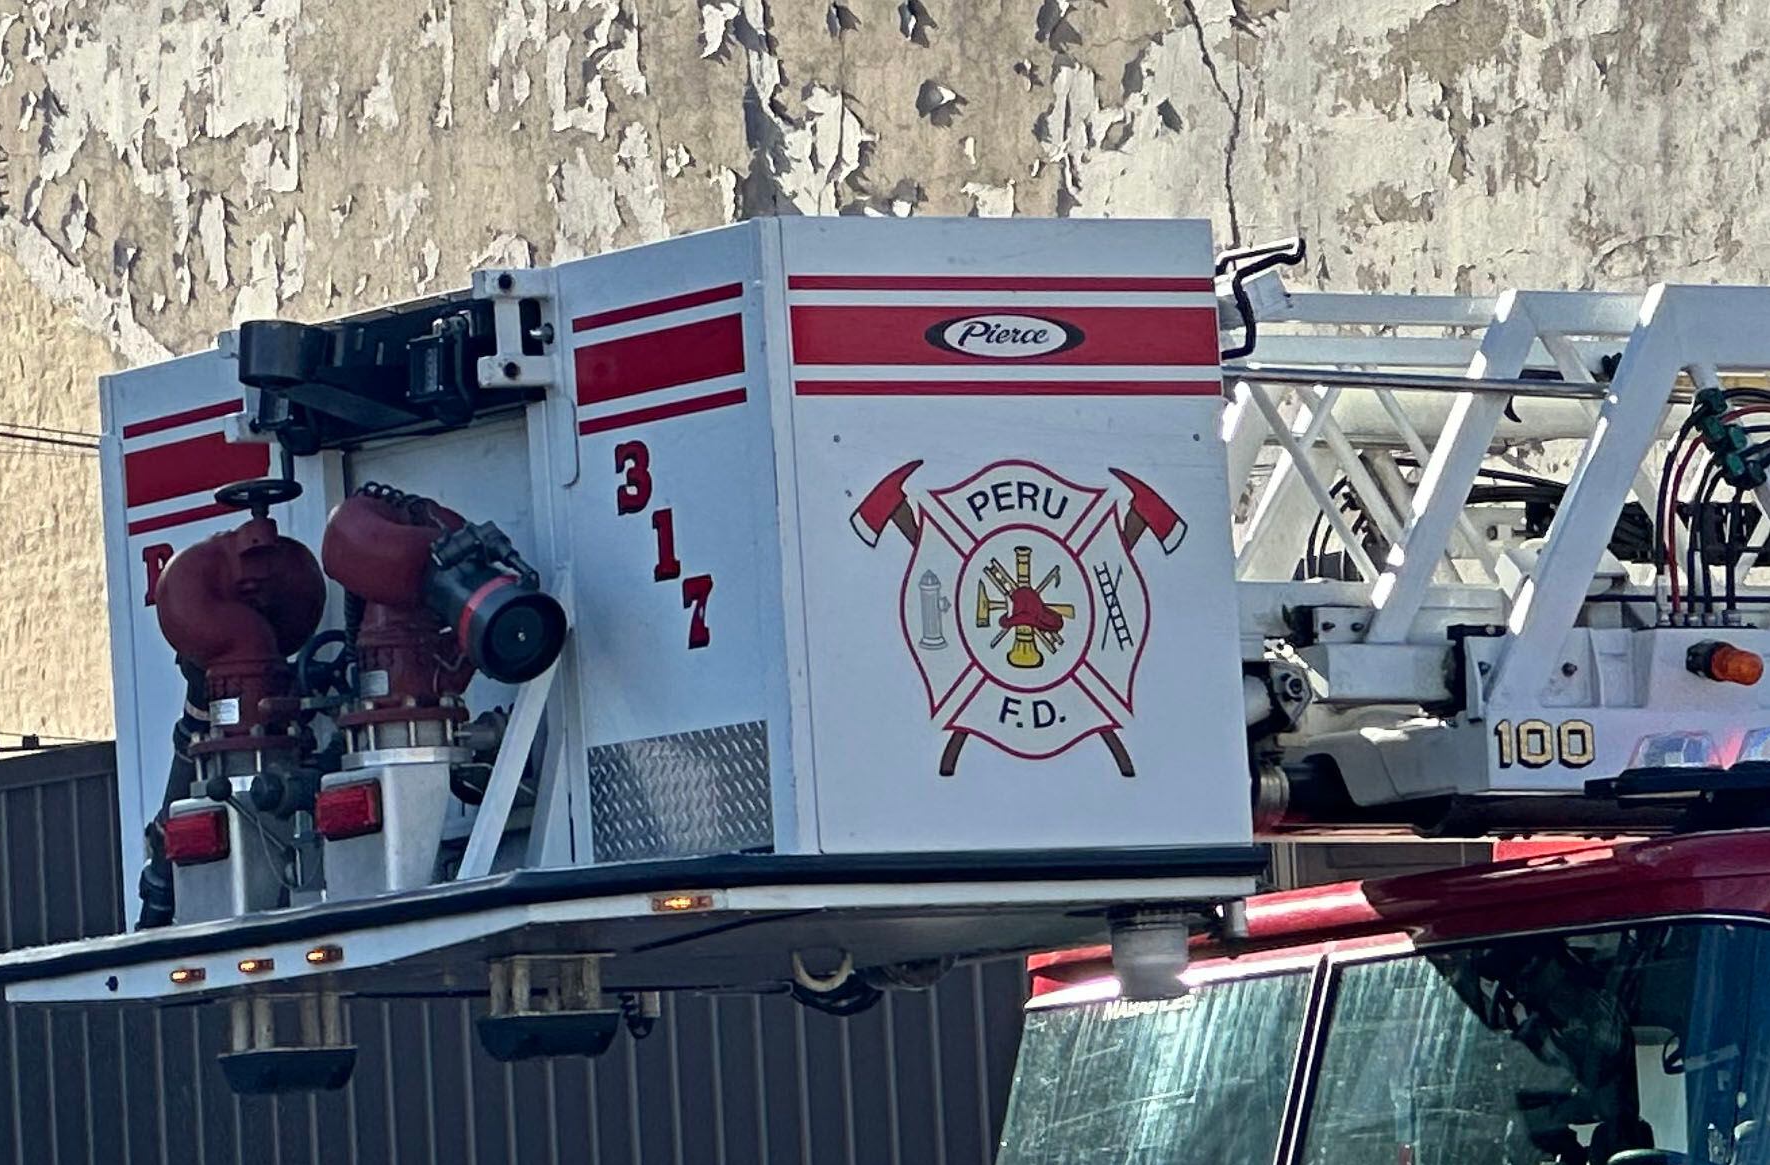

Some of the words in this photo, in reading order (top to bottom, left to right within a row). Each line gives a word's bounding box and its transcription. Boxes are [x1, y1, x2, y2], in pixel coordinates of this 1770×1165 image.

[958, 321, 1049, 347] Pierce
[966, 481, 1069, 521] PERU
[998, 696, 1066, 729] F.D.
[1494, 719, 1595, 769] 100
